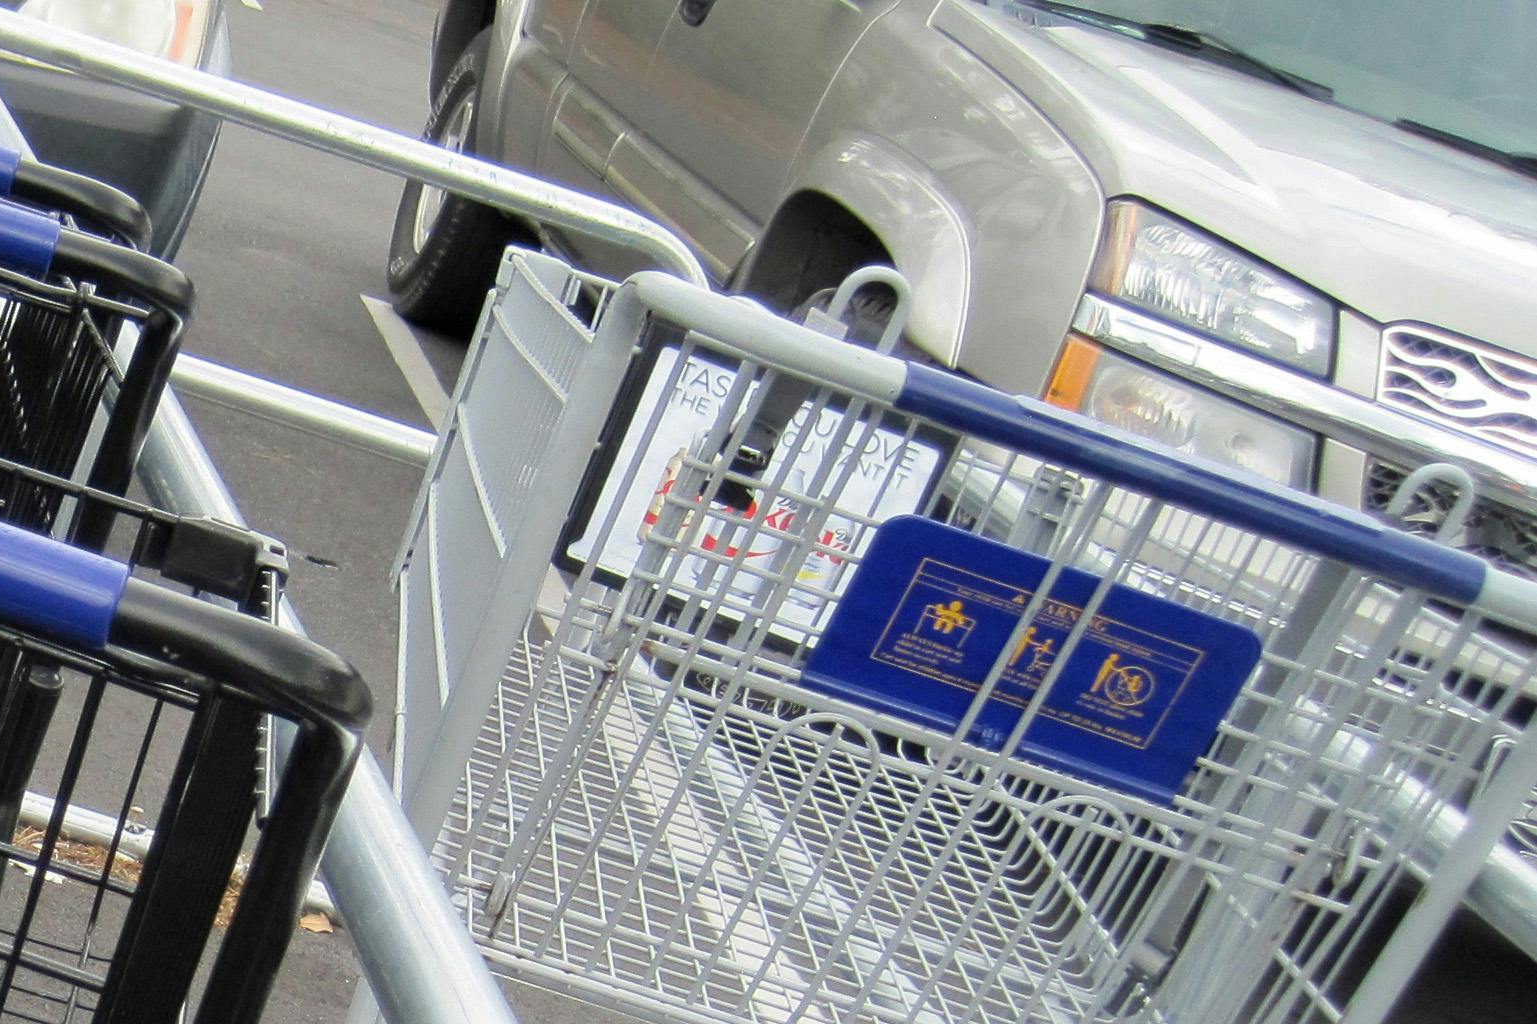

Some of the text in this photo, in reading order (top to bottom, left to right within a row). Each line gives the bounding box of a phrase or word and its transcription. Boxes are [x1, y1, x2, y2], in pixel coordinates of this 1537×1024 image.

[671, 388, 709, 416] THE
[791, 403, 837, 437] OU
[842, 430, 921, 472] OVE
